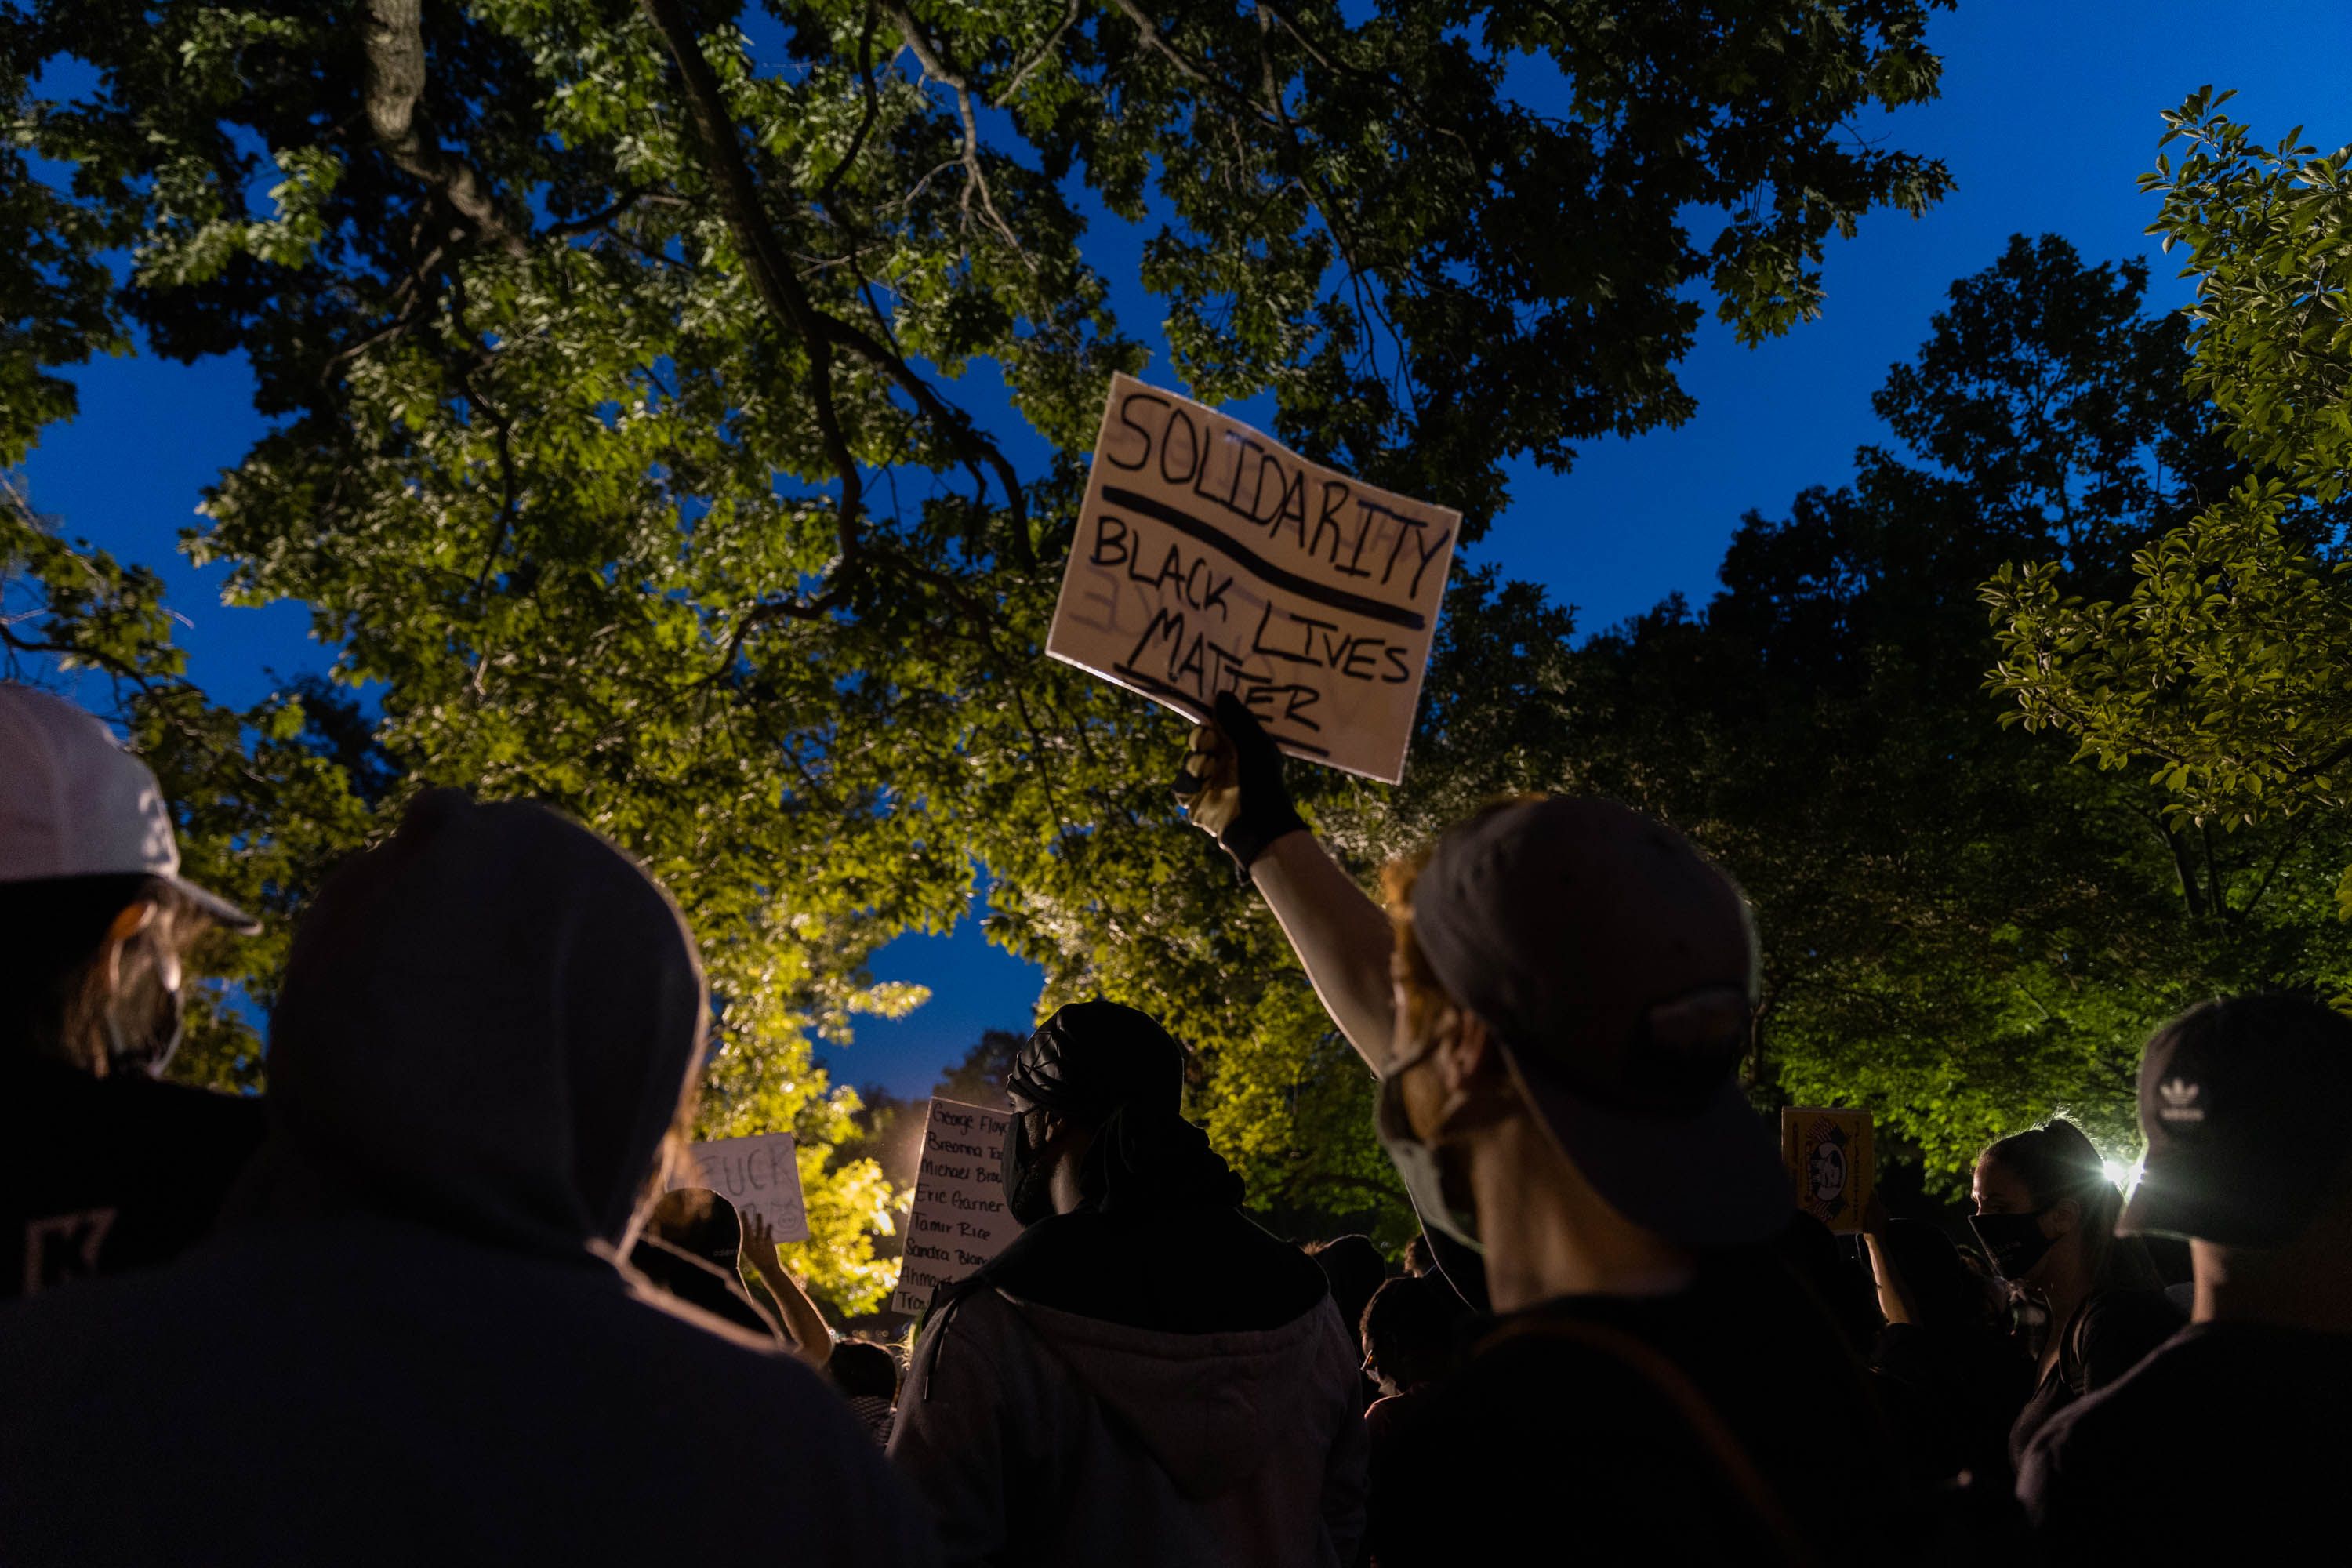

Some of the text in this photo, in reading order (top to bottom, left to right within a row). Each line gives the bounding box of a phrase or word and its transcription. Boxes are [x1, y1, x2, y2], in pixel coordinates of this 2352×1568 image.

[1107, 394, 1450, 599] SOLIDARITY
[1090, 516, 1234, 622] BLACK
[1252, 601, 1410, 684] LIVES
[1127, 608, 1321, 732] MATTER
[932, 1102, 974, 1135] George
[927, 1131, 982, 1158] Breonna
[920, 1157, 971, 1180] Michael
[915, 1184, 1004, 1213] Eric Garner
[912, 1211, 992, 1241] Tamir Rice
[905, 1237, 950, 1261] Sandra
